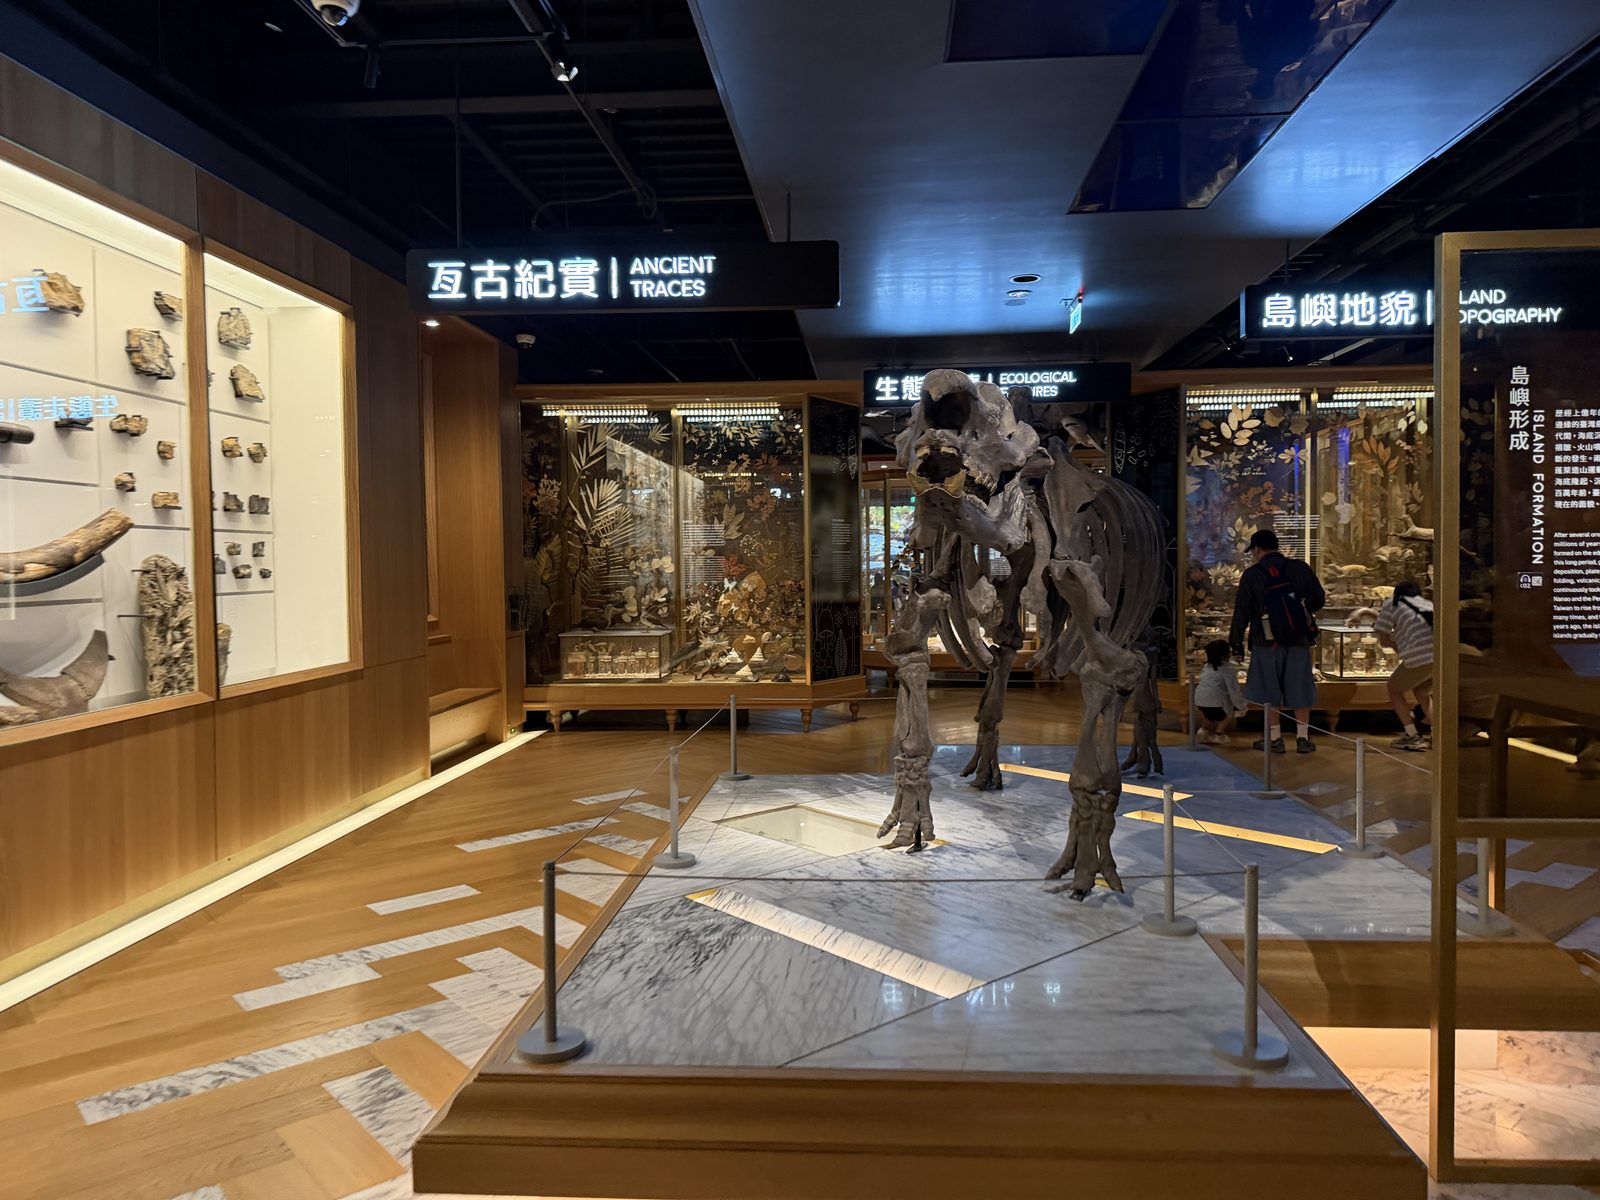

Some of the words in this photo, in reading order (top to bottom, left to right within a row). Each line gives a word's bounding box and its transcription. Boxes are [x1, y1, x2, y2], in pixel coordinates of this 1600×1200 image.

[428, 257, 600, 301] 亙古紀實
[630, 256, 717, 275] ANCIENT
[630, 279, 706, 298] TRACES
[1460, 289, 1507, 304] LAND
[1262, 291, 1417, 328] 島嶼地貌
[1460, 307, 1563, 326] OPOGRAPHY
[1000, 371, 1077, 385] ECOLOGICAL
[1508, 365, 1530, 451] 島嶼形成
[1532, 409, 1545, 464] ISLAND
[1531, 473, 1545, 564] FORMATION
